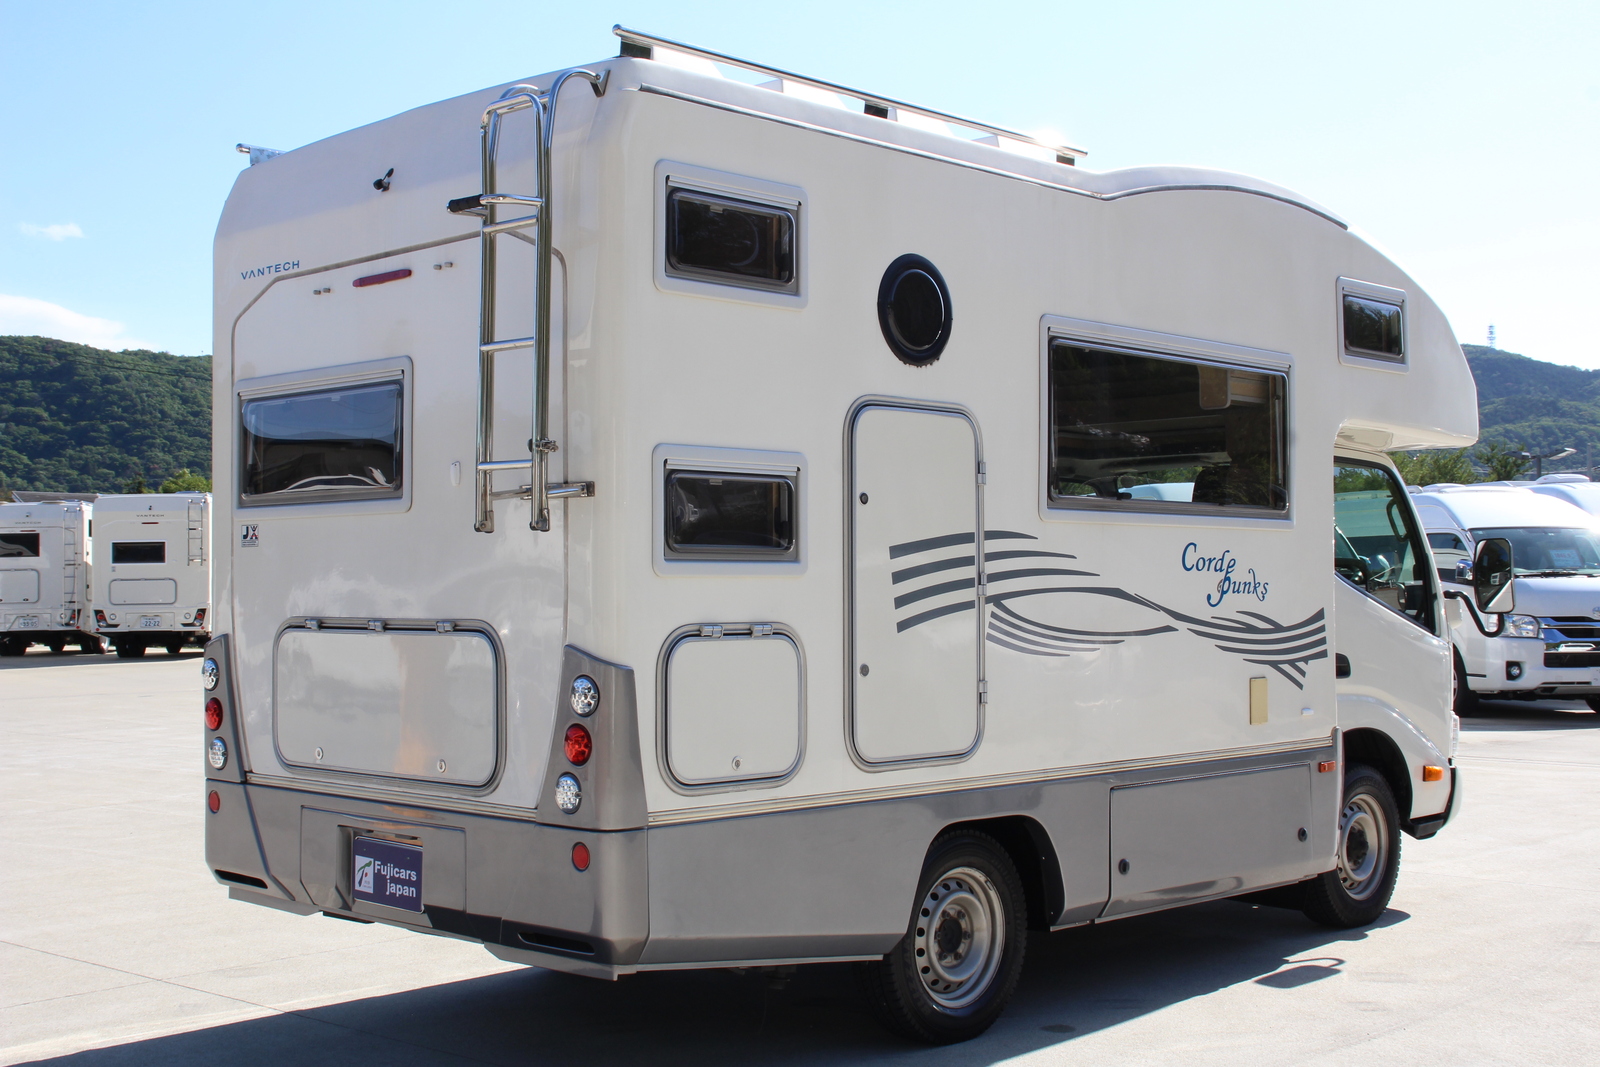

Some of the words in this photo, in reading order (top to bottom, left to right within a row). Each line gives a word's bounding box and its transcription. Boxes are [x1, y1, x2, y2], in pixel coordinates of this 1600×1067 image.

[240, 259, 300, 280] VANTECH
[1181, 542, 1237, 573] Corde
[374, 860, 418, 881] Fujicars
[385, 879, 417, 898] japan
